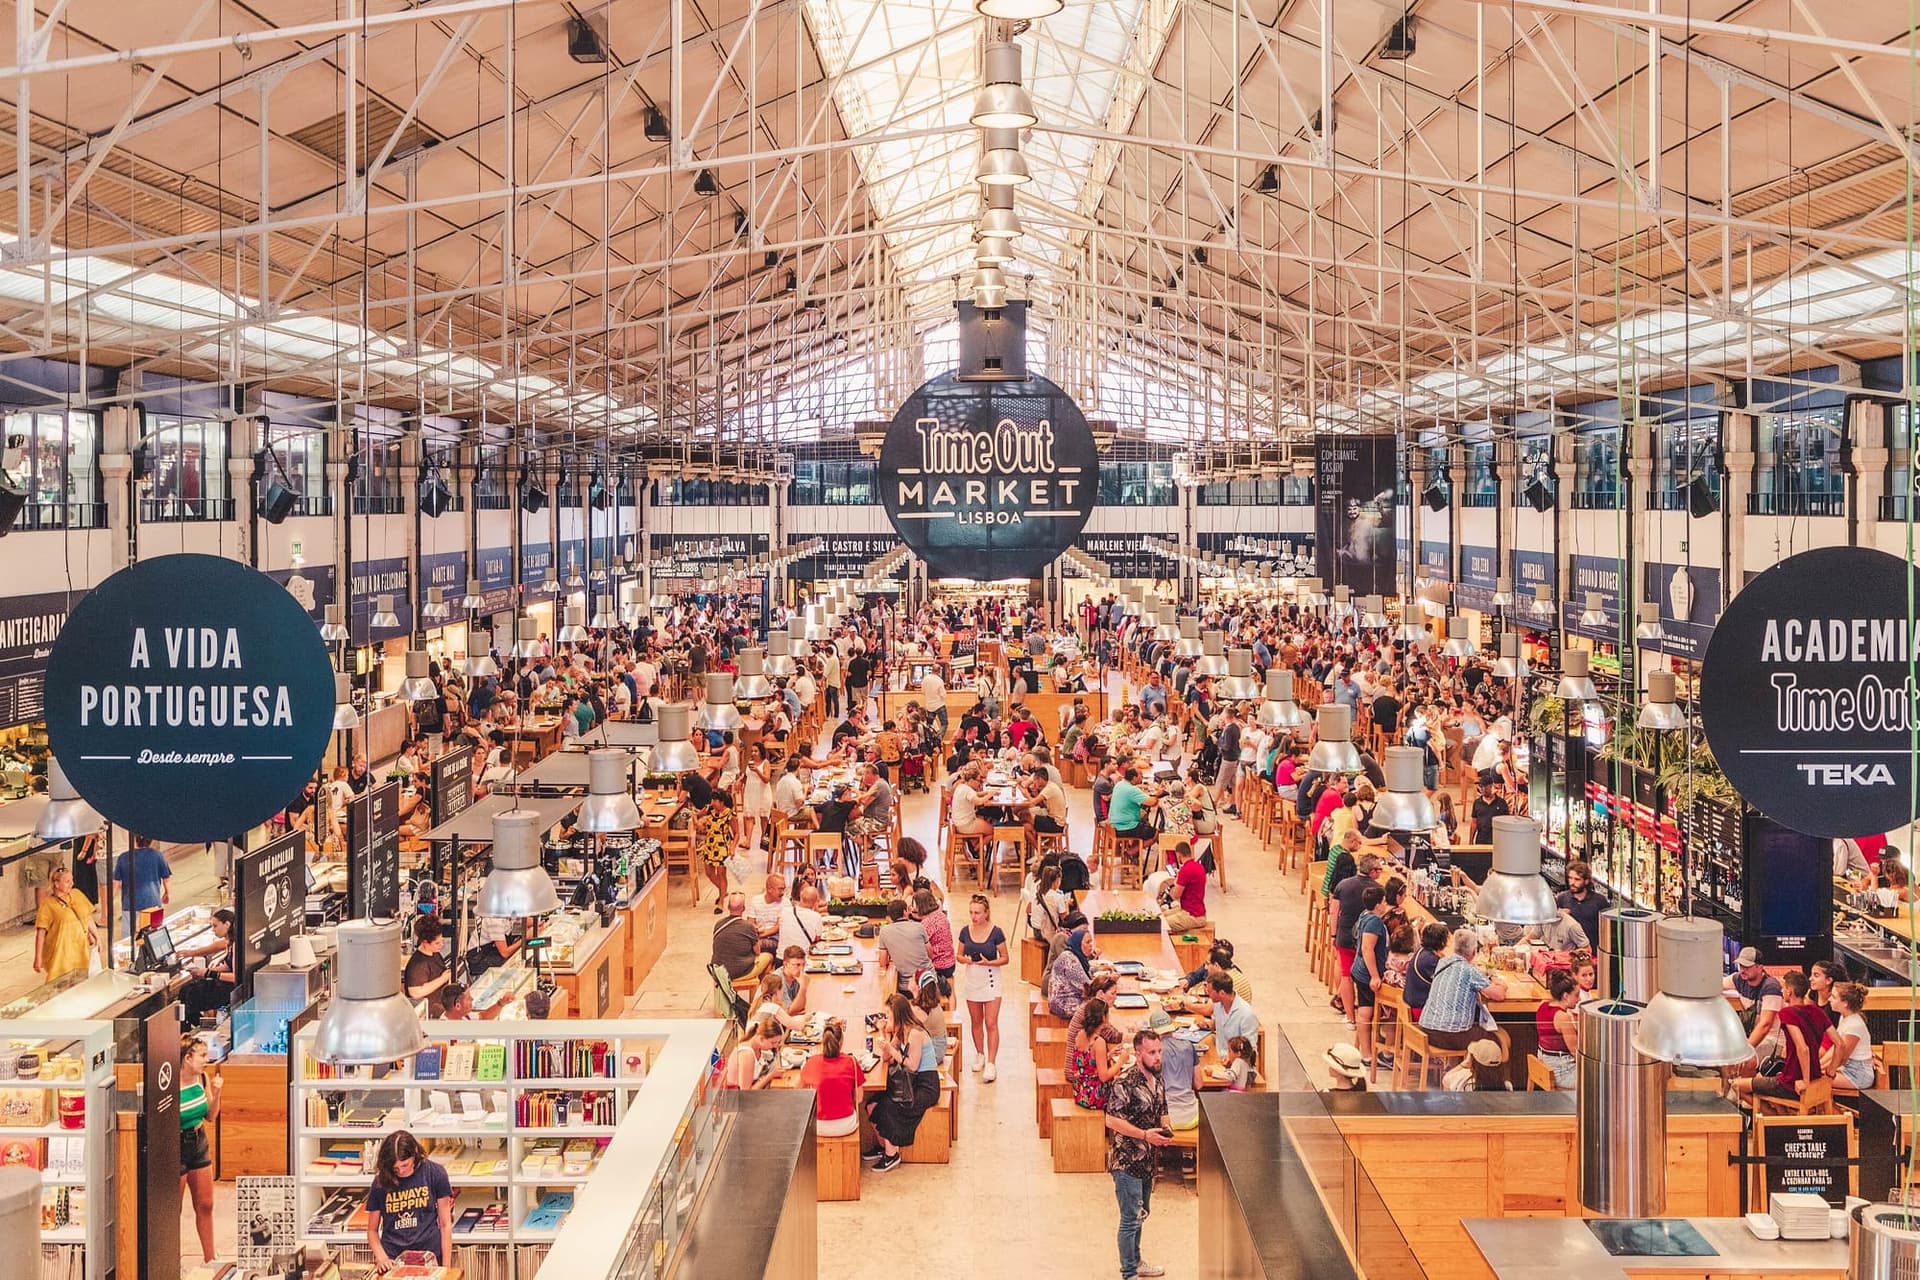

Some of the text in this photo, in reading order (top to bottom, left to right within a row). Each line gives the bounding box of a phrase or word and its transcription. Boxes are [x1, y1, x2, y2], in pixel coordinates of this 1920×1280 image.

[915, 417, 1055, 473] Time Out
[898, 479, 1080, 505] MARKET
[957, 511, 1022, 525] LISBOA
[832, 540, 863, 552] CASTRO
[865, 540, 871, 551] E
[872, 540, 896, 552] SILVA
[1086, 539, 1123, 551] MARLENE
[130, 627, 242, 669] A VIDA
[80, 685, 293, 727] PORTUGUESA
[1771, 673, 1855, 731] Time
[137, 749, 235, 766] Desde sempre
[1797, 763, 1896, 786] TEKA
[1784, 1142, 1827, 1152] CHEF'S TABLE
[385, 1186, 429, 1203] ALWAYS
[385, 1196, 430, 1213] REPPIN'
